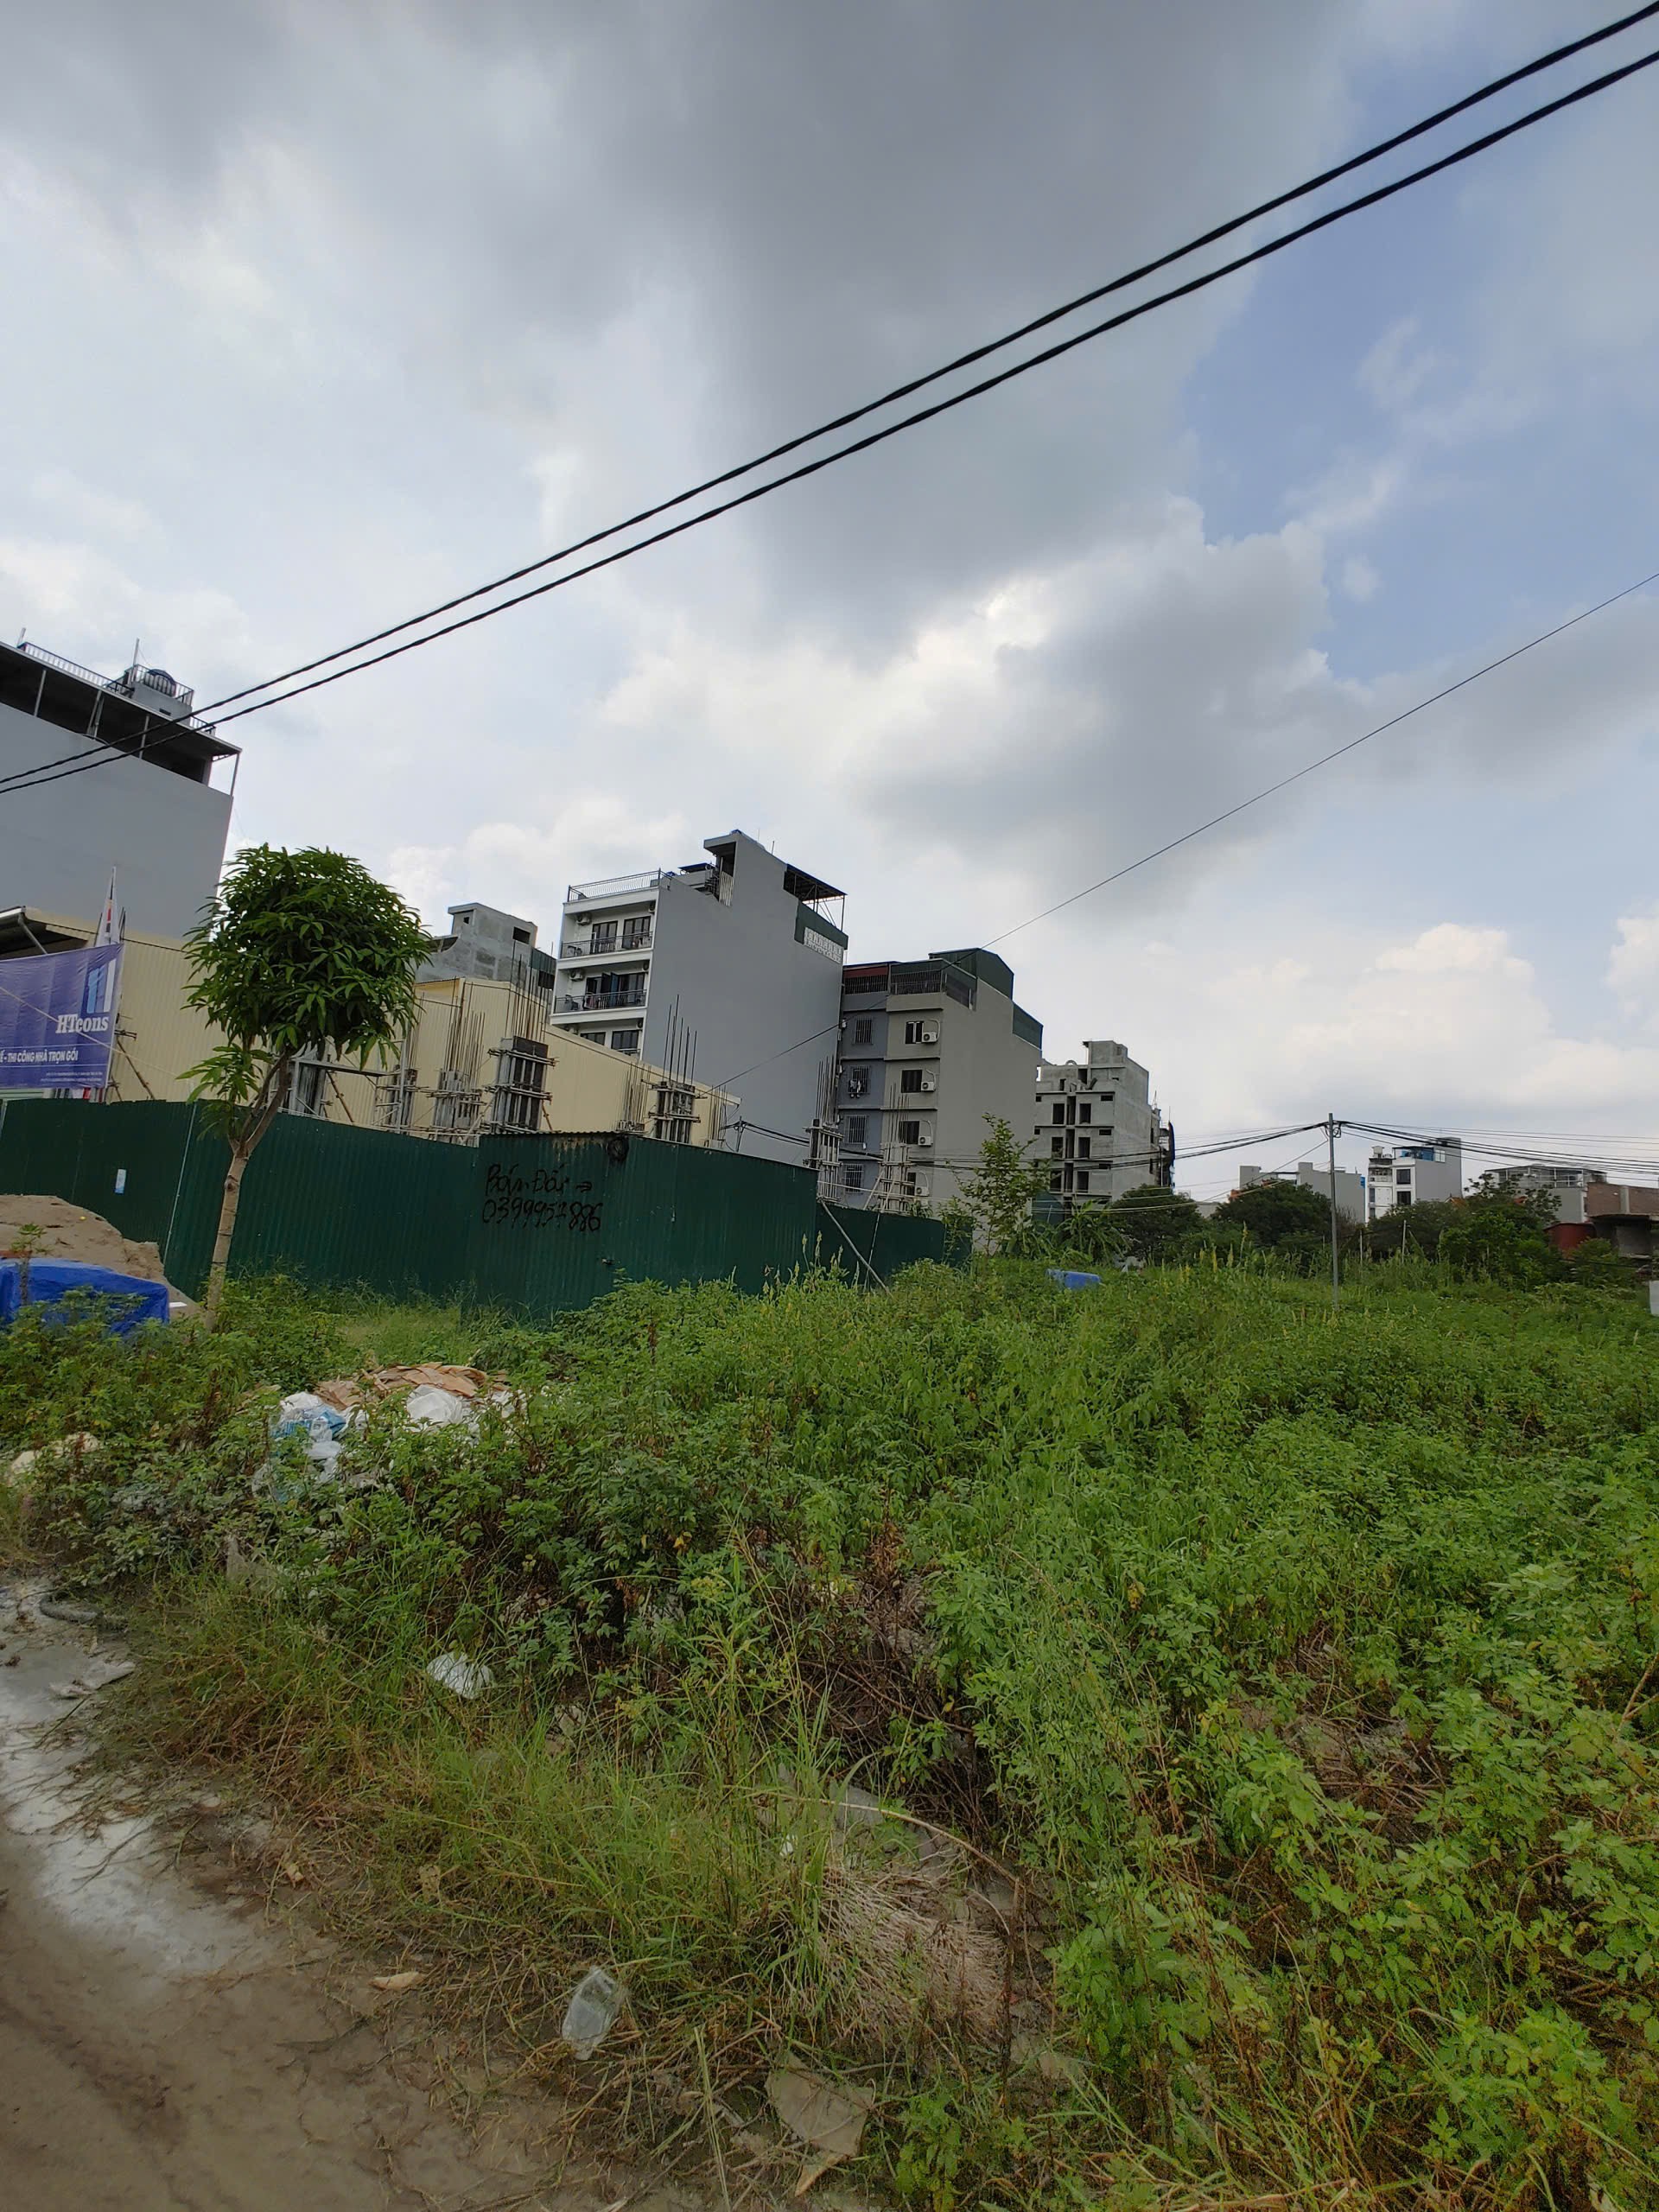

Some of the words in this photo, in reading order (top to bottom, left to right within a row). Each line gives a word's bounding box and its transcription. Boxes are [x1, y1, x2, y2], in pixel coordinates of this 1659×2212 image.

[55, 1014, 110, 1033] HTcons
[48, 1050, 66, 1064] TRỌN
[66, 1047, 79, 1061] GÓI
